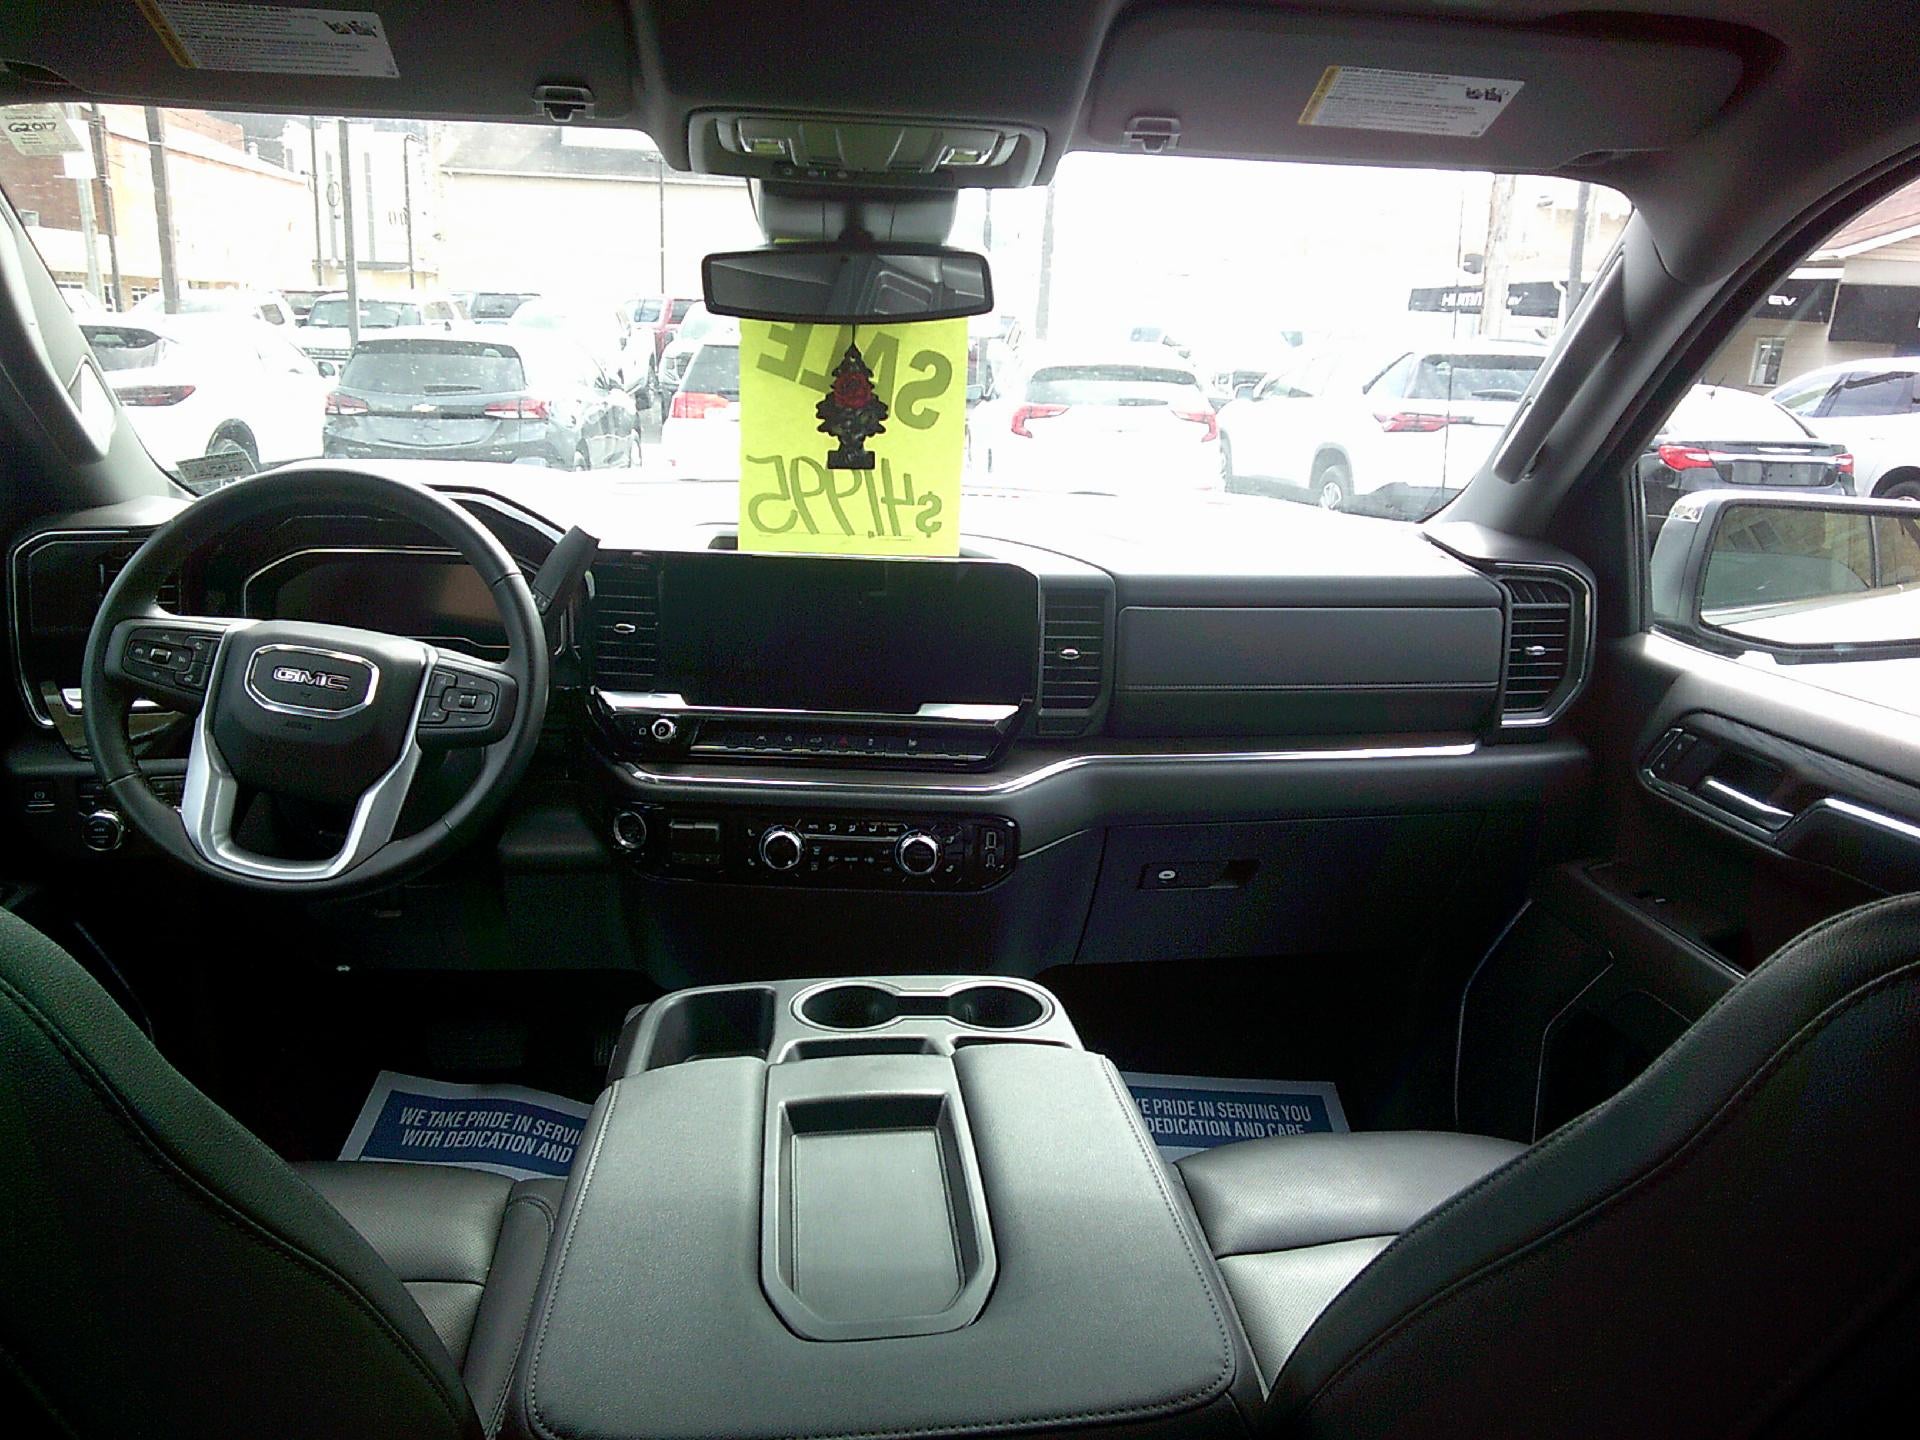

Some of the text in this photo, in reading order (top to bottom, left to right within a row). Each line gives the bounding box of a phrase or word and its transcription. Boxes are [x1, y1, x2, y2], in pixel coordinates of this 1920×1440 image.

[1768, 295, 1796, 306] EV
[273, 667, 351, 690] GMC
[400, 1107, 427, 1126] WE
[426, 1110, 466, 1128] TAKE
[464, 1111, 515, 1129] PRIDE
[514, 1114, 533, 1132] IN
[1153, 1099, 1197, 1116] PRIDE
[1198, 1101, 1215, 1117] IN
[1217, 1102, 1279, 1121] SERVING
[1281, 1105, 1312, 1122] YOU
[1145, 1117, 1233, 1136] DEDICATION
[1235, 1121, 1265, 1138] AND
[401, 1129, 574, 1163] WITH DEDICATION AND
